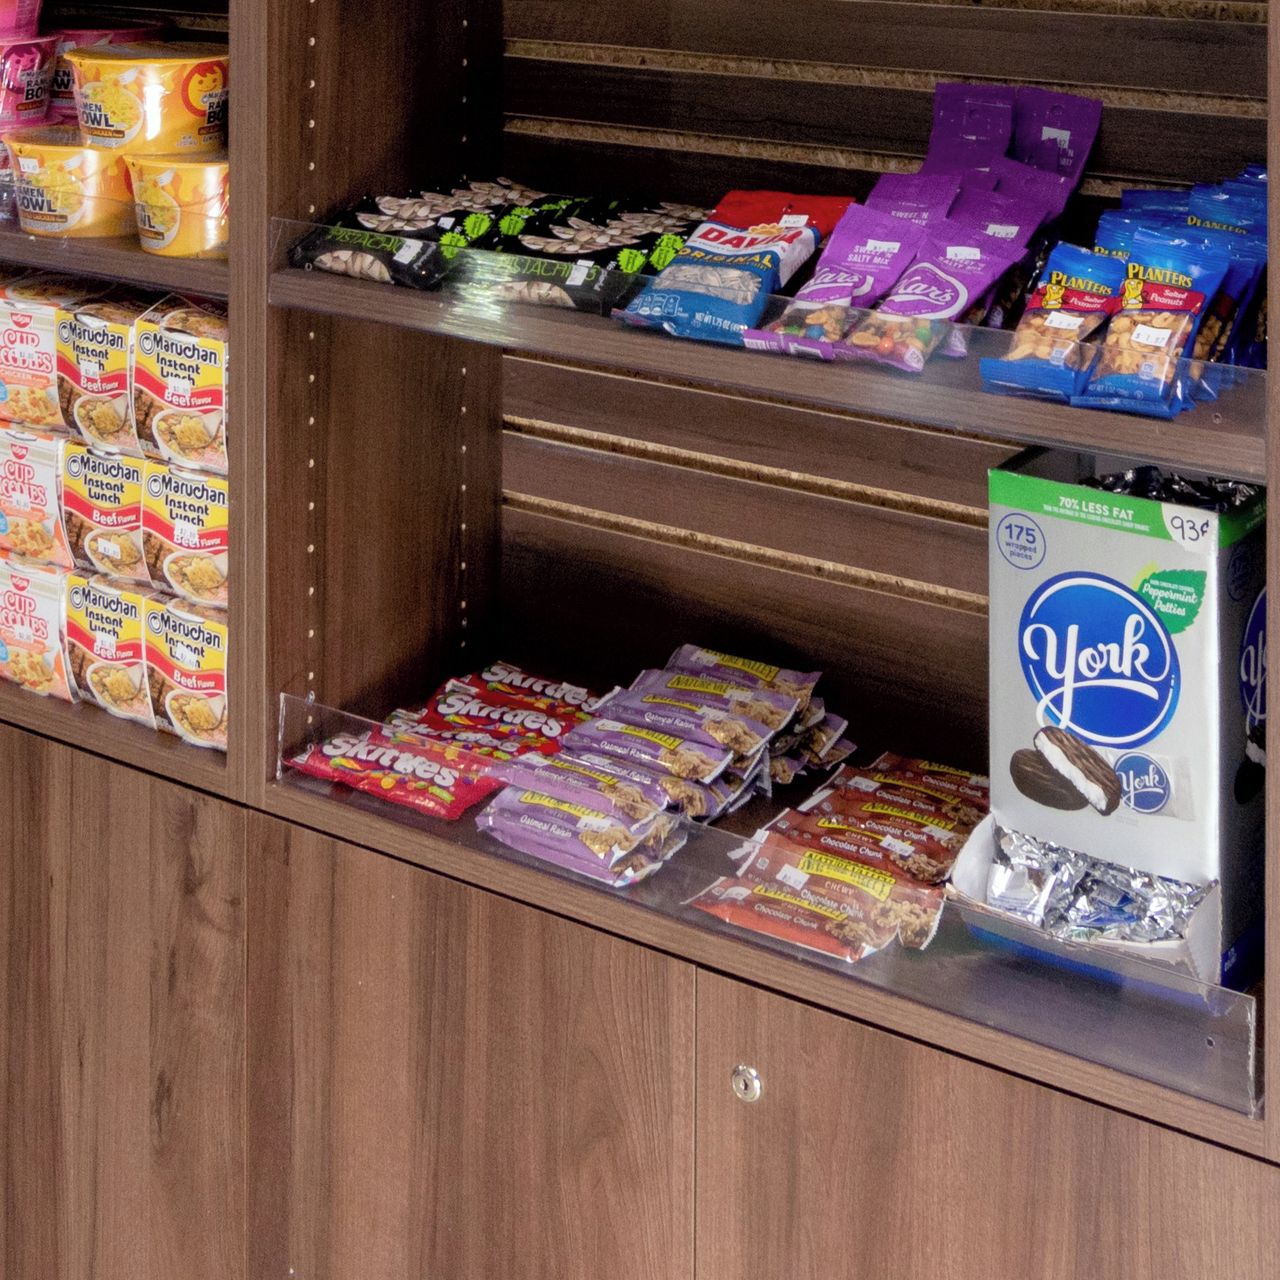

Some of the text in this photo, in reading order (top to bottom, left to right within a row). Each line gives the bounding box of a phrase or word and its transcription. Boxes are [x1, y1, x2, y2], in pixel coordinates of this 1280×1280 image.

[677, 246, 775, 269] ORIGINAL
[1051, 271, 1112, 295] PLANTERS
[1127, 263, 1193, 288] PLANTERS
[1150, 293, 1184, 306] Peanuts
[1163, 289, 1187, 298] Salted
[153, 333, 218, 365] Maruchan
[157, 352, 201, 374] Instant
[80, 455, 140, 483] Maruchan
[84, 474, 125, 493] Instant
[88, 488, 120, 504] Lunch
[92, 509, 117, 525] Beef
[1058, 496, 1080, 510] 70%
[1082, 501, 1110, 516] LESS
[1112, 509, 1134, 521] FAT
[1004, 523, 1036, 544] 175
[1005, 541, 1037, 554] wrapped
[82, 588, 137, 619] Maruchan
[1143, 582, 1198, 604] Peppermint
[161, 613, 221, 649] Maruchan
[174, 670, 197, 688] Beef
[1023, 613, 1171, 729] York
[865, 820, 928, 842] Chocolate Chunk
[821, 836, 883, 860] Chocolate Chunk
[754, 903, 818, 930] Chocolate Chunk
